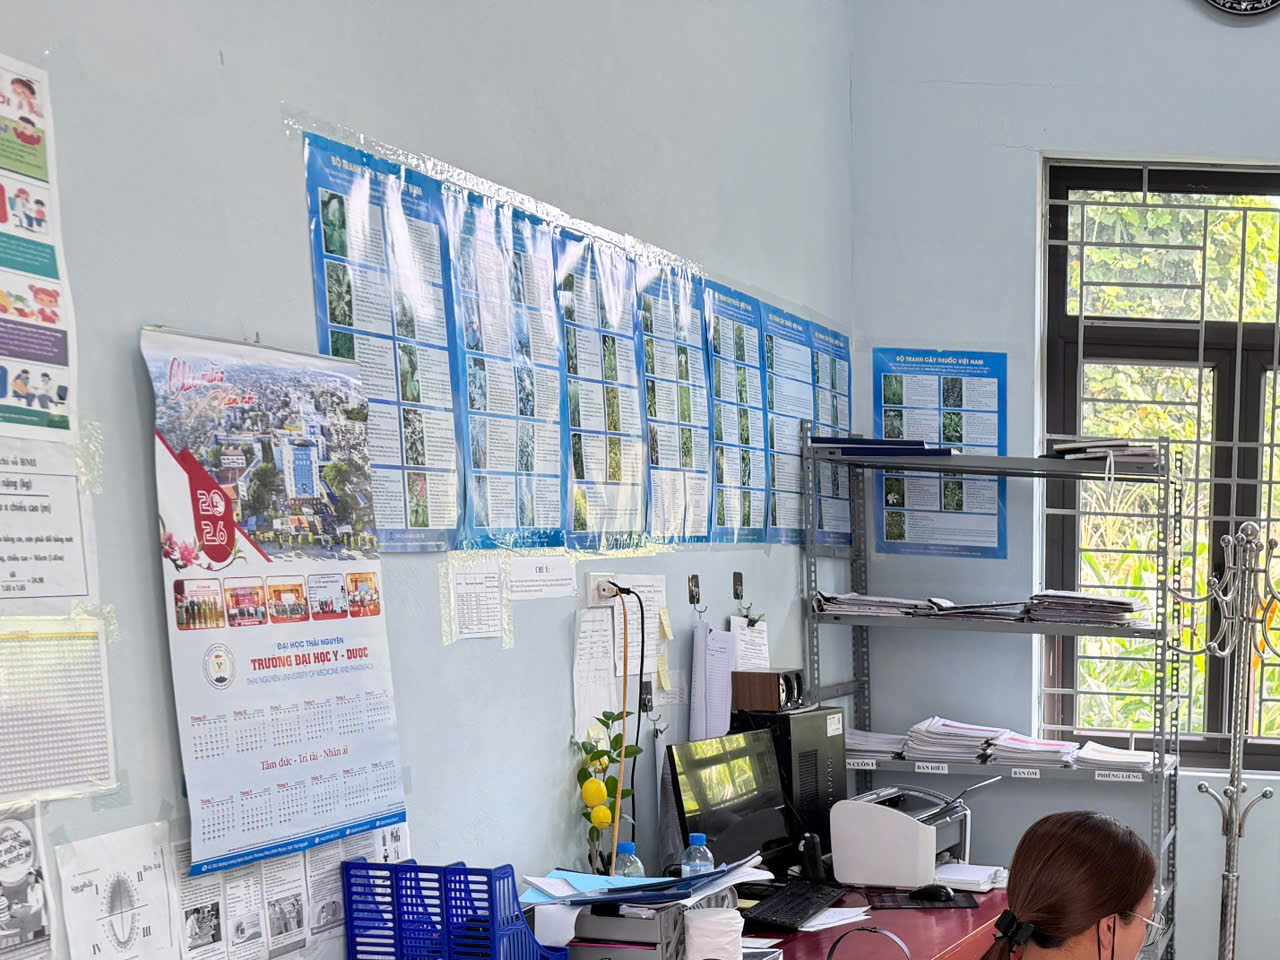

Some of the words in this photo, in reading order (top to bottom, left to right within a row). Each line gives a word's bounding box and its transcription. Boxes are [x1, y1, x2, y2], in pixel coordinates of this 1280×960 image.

[197, 489, 225, 516] 20
[201, 521, 227, 545] 26
[277, 642, 289, 651] ĐẠI
[290, 640, 304, 650] HỌC
[250, 654, 292, 671] TRƯỜNG
[294, 652, 311, 667] ĐẠI
[313, 651, 331, 666] HỌC
[332, 650, 339, 661] Y
[143, 926, 151, 938] III
